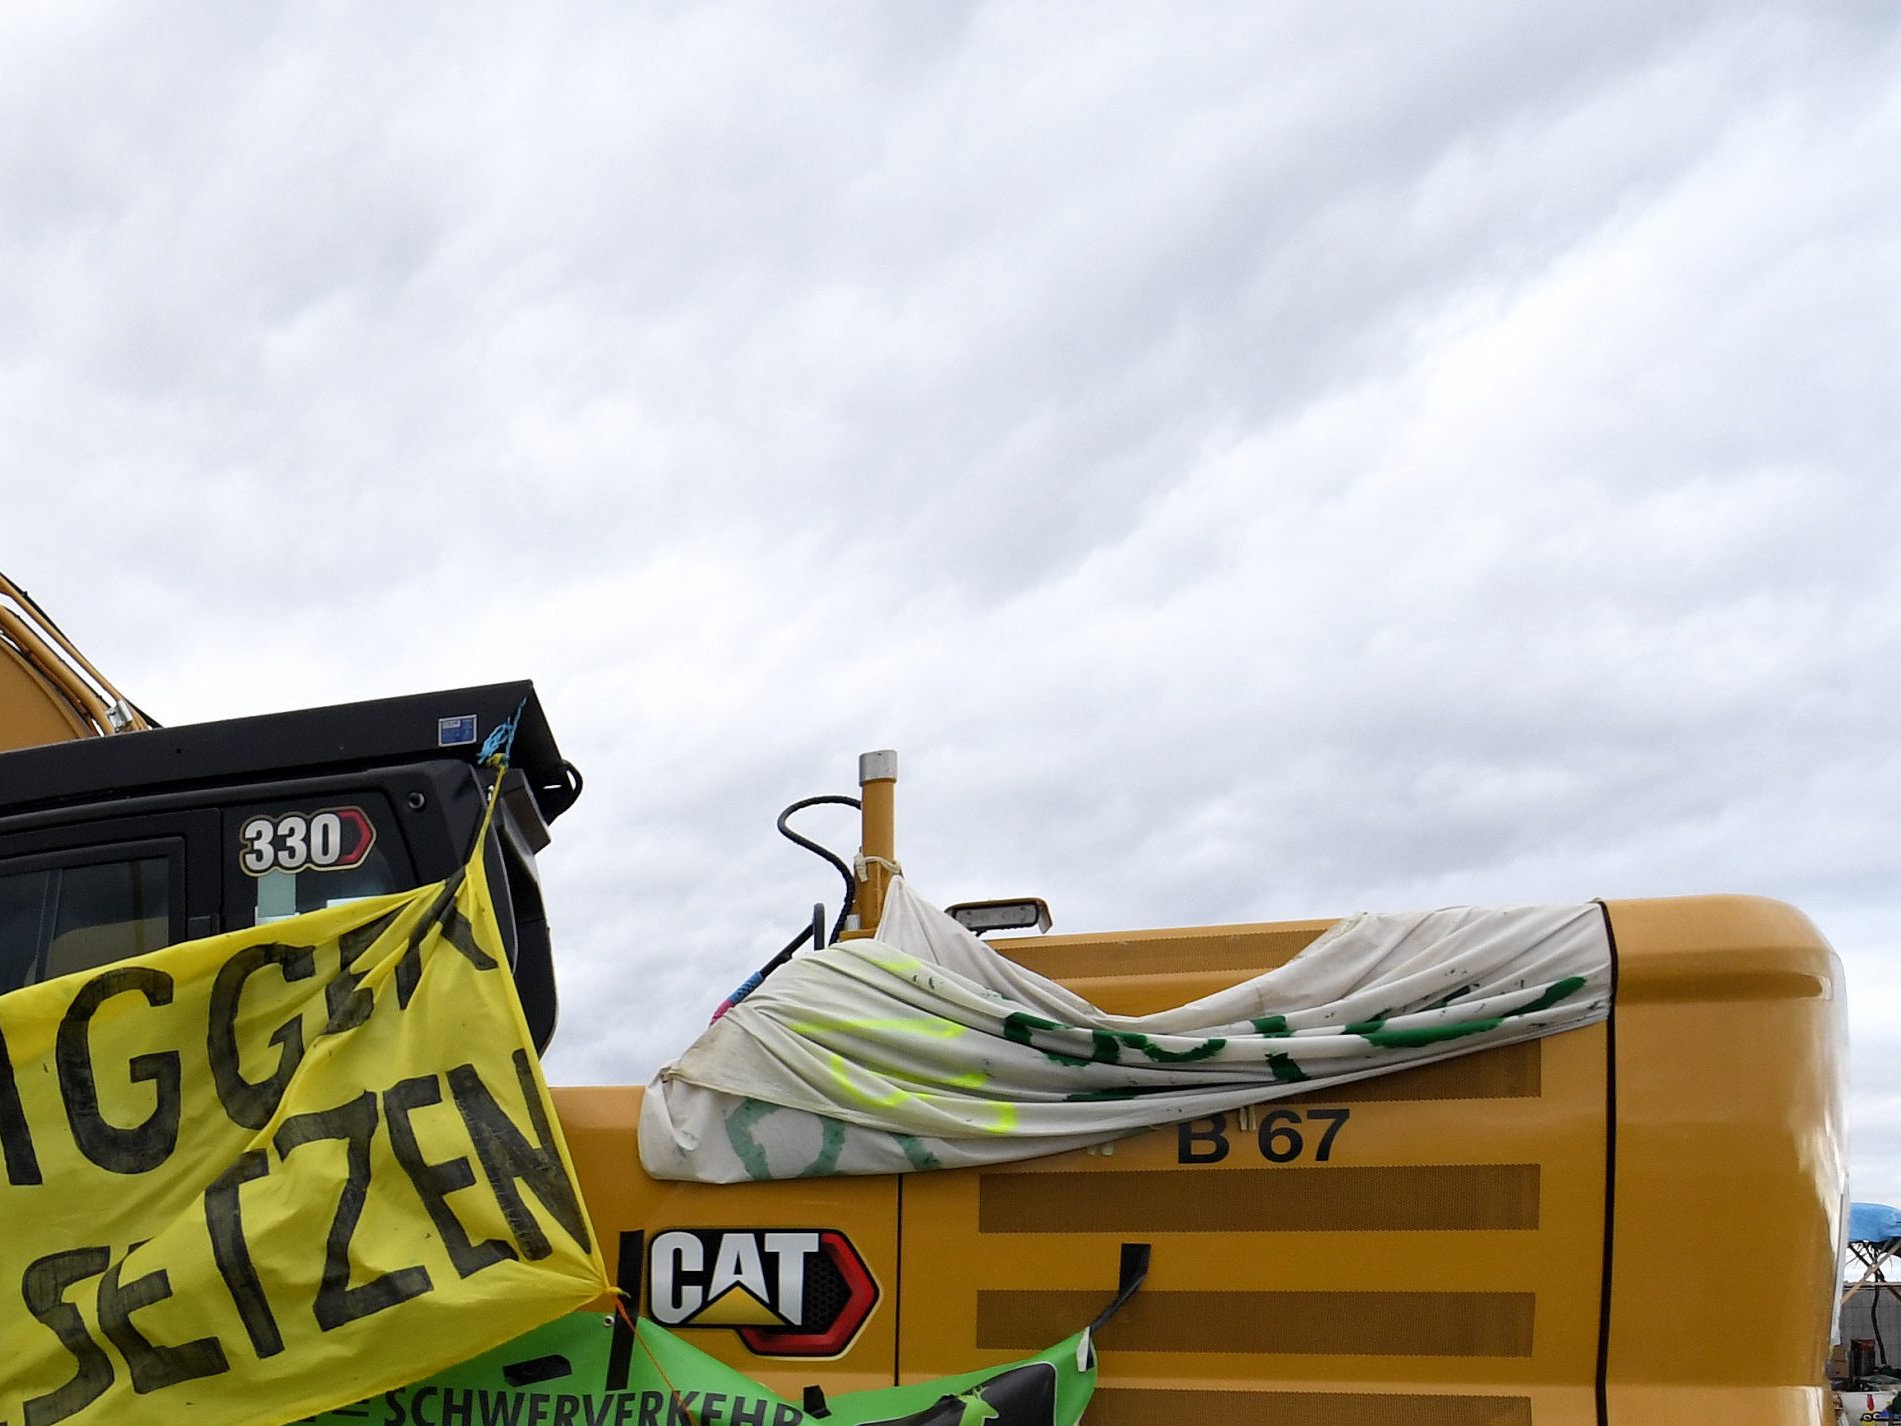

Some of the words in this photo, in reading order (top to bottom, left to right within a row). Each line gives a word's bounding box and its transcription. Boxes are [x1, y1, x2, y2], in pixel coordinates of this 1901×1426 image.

[244, 812, 341, 871] 330
[1178, 1113, 1230, 1164] B
[1258, 1109, 1350, 1163] 67
[651, 1231, 819, 1326] CAT
